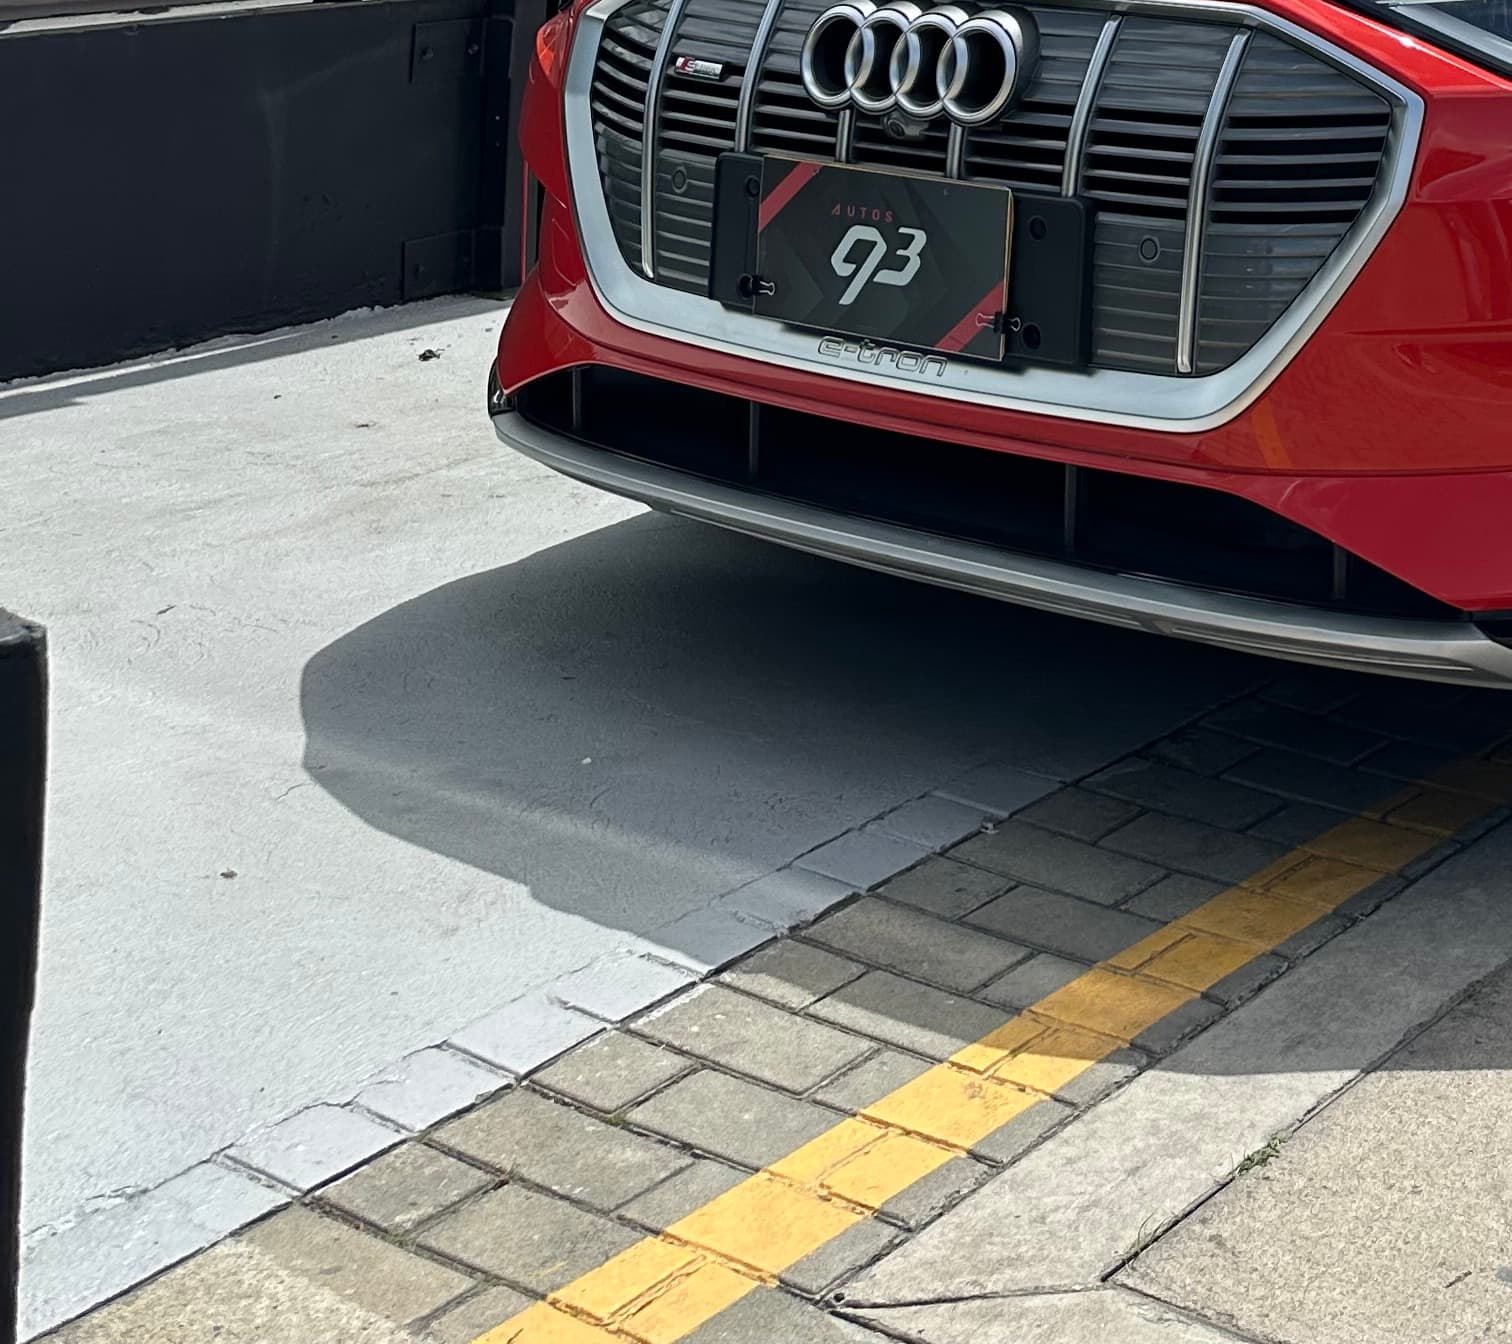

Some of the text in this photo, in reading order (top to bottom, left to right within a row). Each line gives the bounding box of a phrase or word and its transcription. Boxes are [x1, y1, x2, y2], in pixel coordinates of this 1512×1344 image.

[831, 203, 894, 223] AUTOS
[830, 224, 928, 306] 93
[817, 335, 949, 378] e-tron
